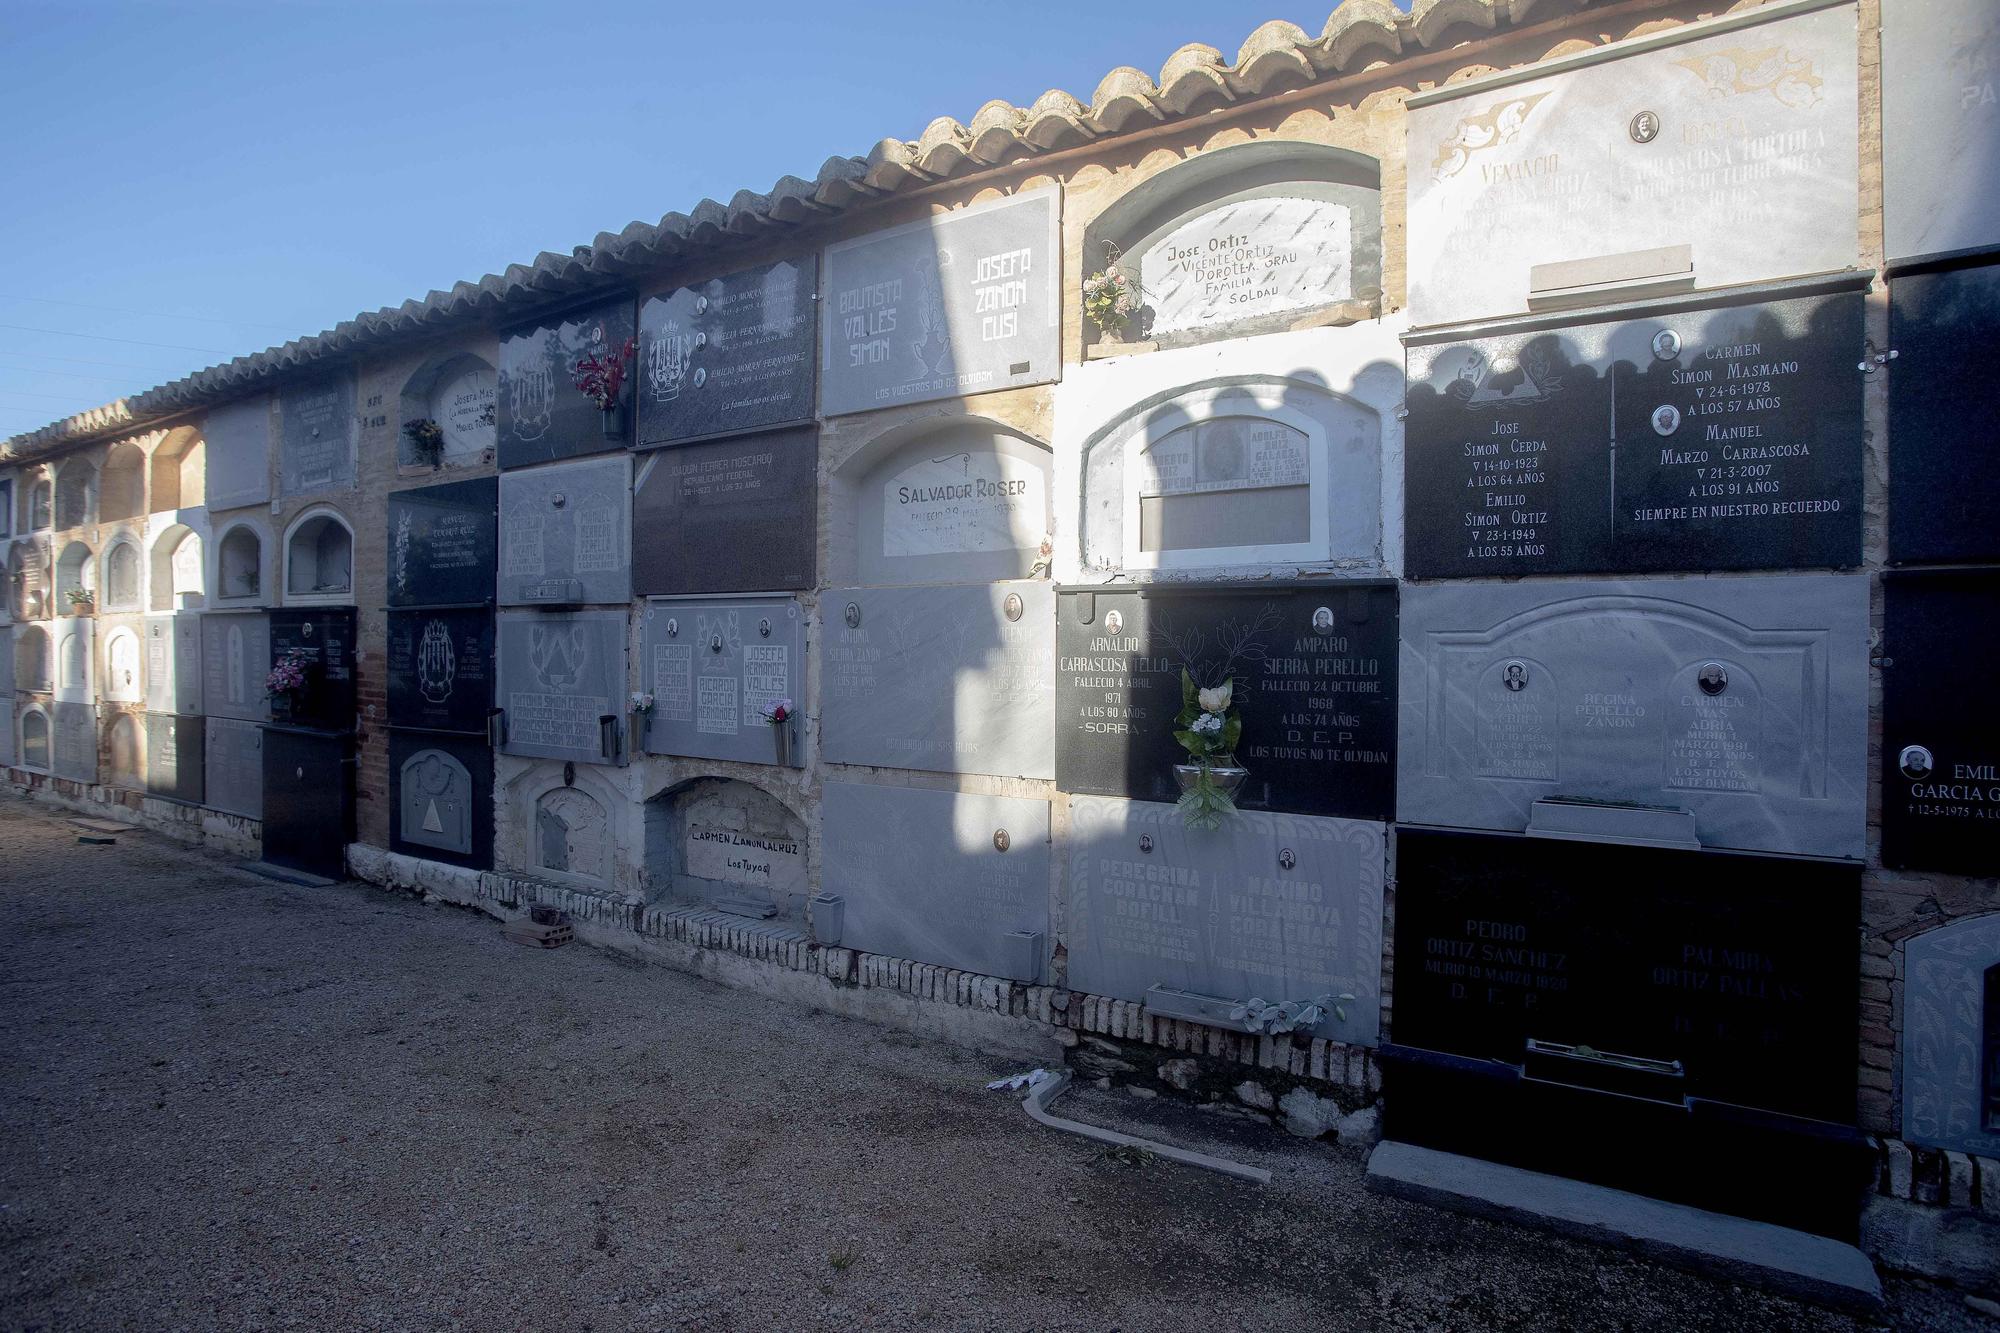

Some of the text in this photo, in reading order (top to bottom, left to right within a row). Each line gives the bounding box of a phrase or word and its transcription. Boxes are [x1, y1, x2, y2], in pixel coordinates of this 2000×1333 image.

[971, 248, 1031, 284] JOSEFA
[839, 279, 903, 314] BAUTISTA
[974, 279, 1027, 314] ZANON
[850, 338, 890, 367] SIMON
[1705, 343, 1761, 360] CARMEN
[1671, 361, 1799, 384] SIMON MASMANO
[875, 387, 890, 400] LOS
[1709, 381, 1771, 398] 24-6-1978
[1688, 394, 1781, 417] A LOS 57 AÑOS
[1492, 420, 1520, 434] JOSE
[1705, 424, 1763, 441] MANUEL
[1464, 439, 1548, 456] SIMON CERDA
[1660, 443, 1810, 465] MARZO CARRASCOSA
[1484, 458, 1538, 471] 14-10-1923
[1710, 465, 1772, 479] 21-3-2007
[1467, 470, 1545, 487] A LOS 64 AÑOS
[899, 479, 1026, 504] SALVADOR ROSER
[1688, 478, 1780, 497] A LOS 91 AÑOS
[1485, 493, 1526, 507] EMILIO
[1464, 510, 1549, 526] SIMON ORTIZ
[1634, 500, 1840, 521] SIEMPRE EN NUESTRO RECUERDO
[1486, 529, 1536, 541] 23-1-1949
[1467, 541, 1545, 557] A LOS 55 AÑOS
[1089, 637, 1139, 652] ARNALDO
[1294, 636, 1348, 653] AMPARO
[747, 647, 784, 661] JOSEFA
[745, 662, 786, 676] HERNANDEZ
[1060, 657, 1168, 672] CARRASCOSA TELLO
[1263, 658, 1378, 676] SIERRA PERELLO
[747, 677, 784, 691] VALLES
[1074, 677, 1153, 689] FALLECIO ABRIL
[1261, 679, 1381, 693] FALLECIO 24 OCTUBRE
[1105, 692, 1121, 704] 1971
[1308, 697, 1333, 709] 1968
[1680, 695, 1745, 708] CARMEN
[1088, 707, 1104, 717] LOS
[1122, 705, 1147, 719] AÑOS
[1281, 712, 1360, 727] A LOS 74 AÑOS
[1695, 708, 1729, 719] MAS
[1585, 717, 1635, 729] ZANON
[1674, 739, 1718, 750] MARZO
[1249, 745, 1388, 764] LOS TUYOS NO TE OLVIDAN
[1911, 783, 1984, 801] GARCIA
[1466, 919, 1527, 942] PEDRO
[1427, 937, 1567, 970] ORTIZ SANCHEZ
